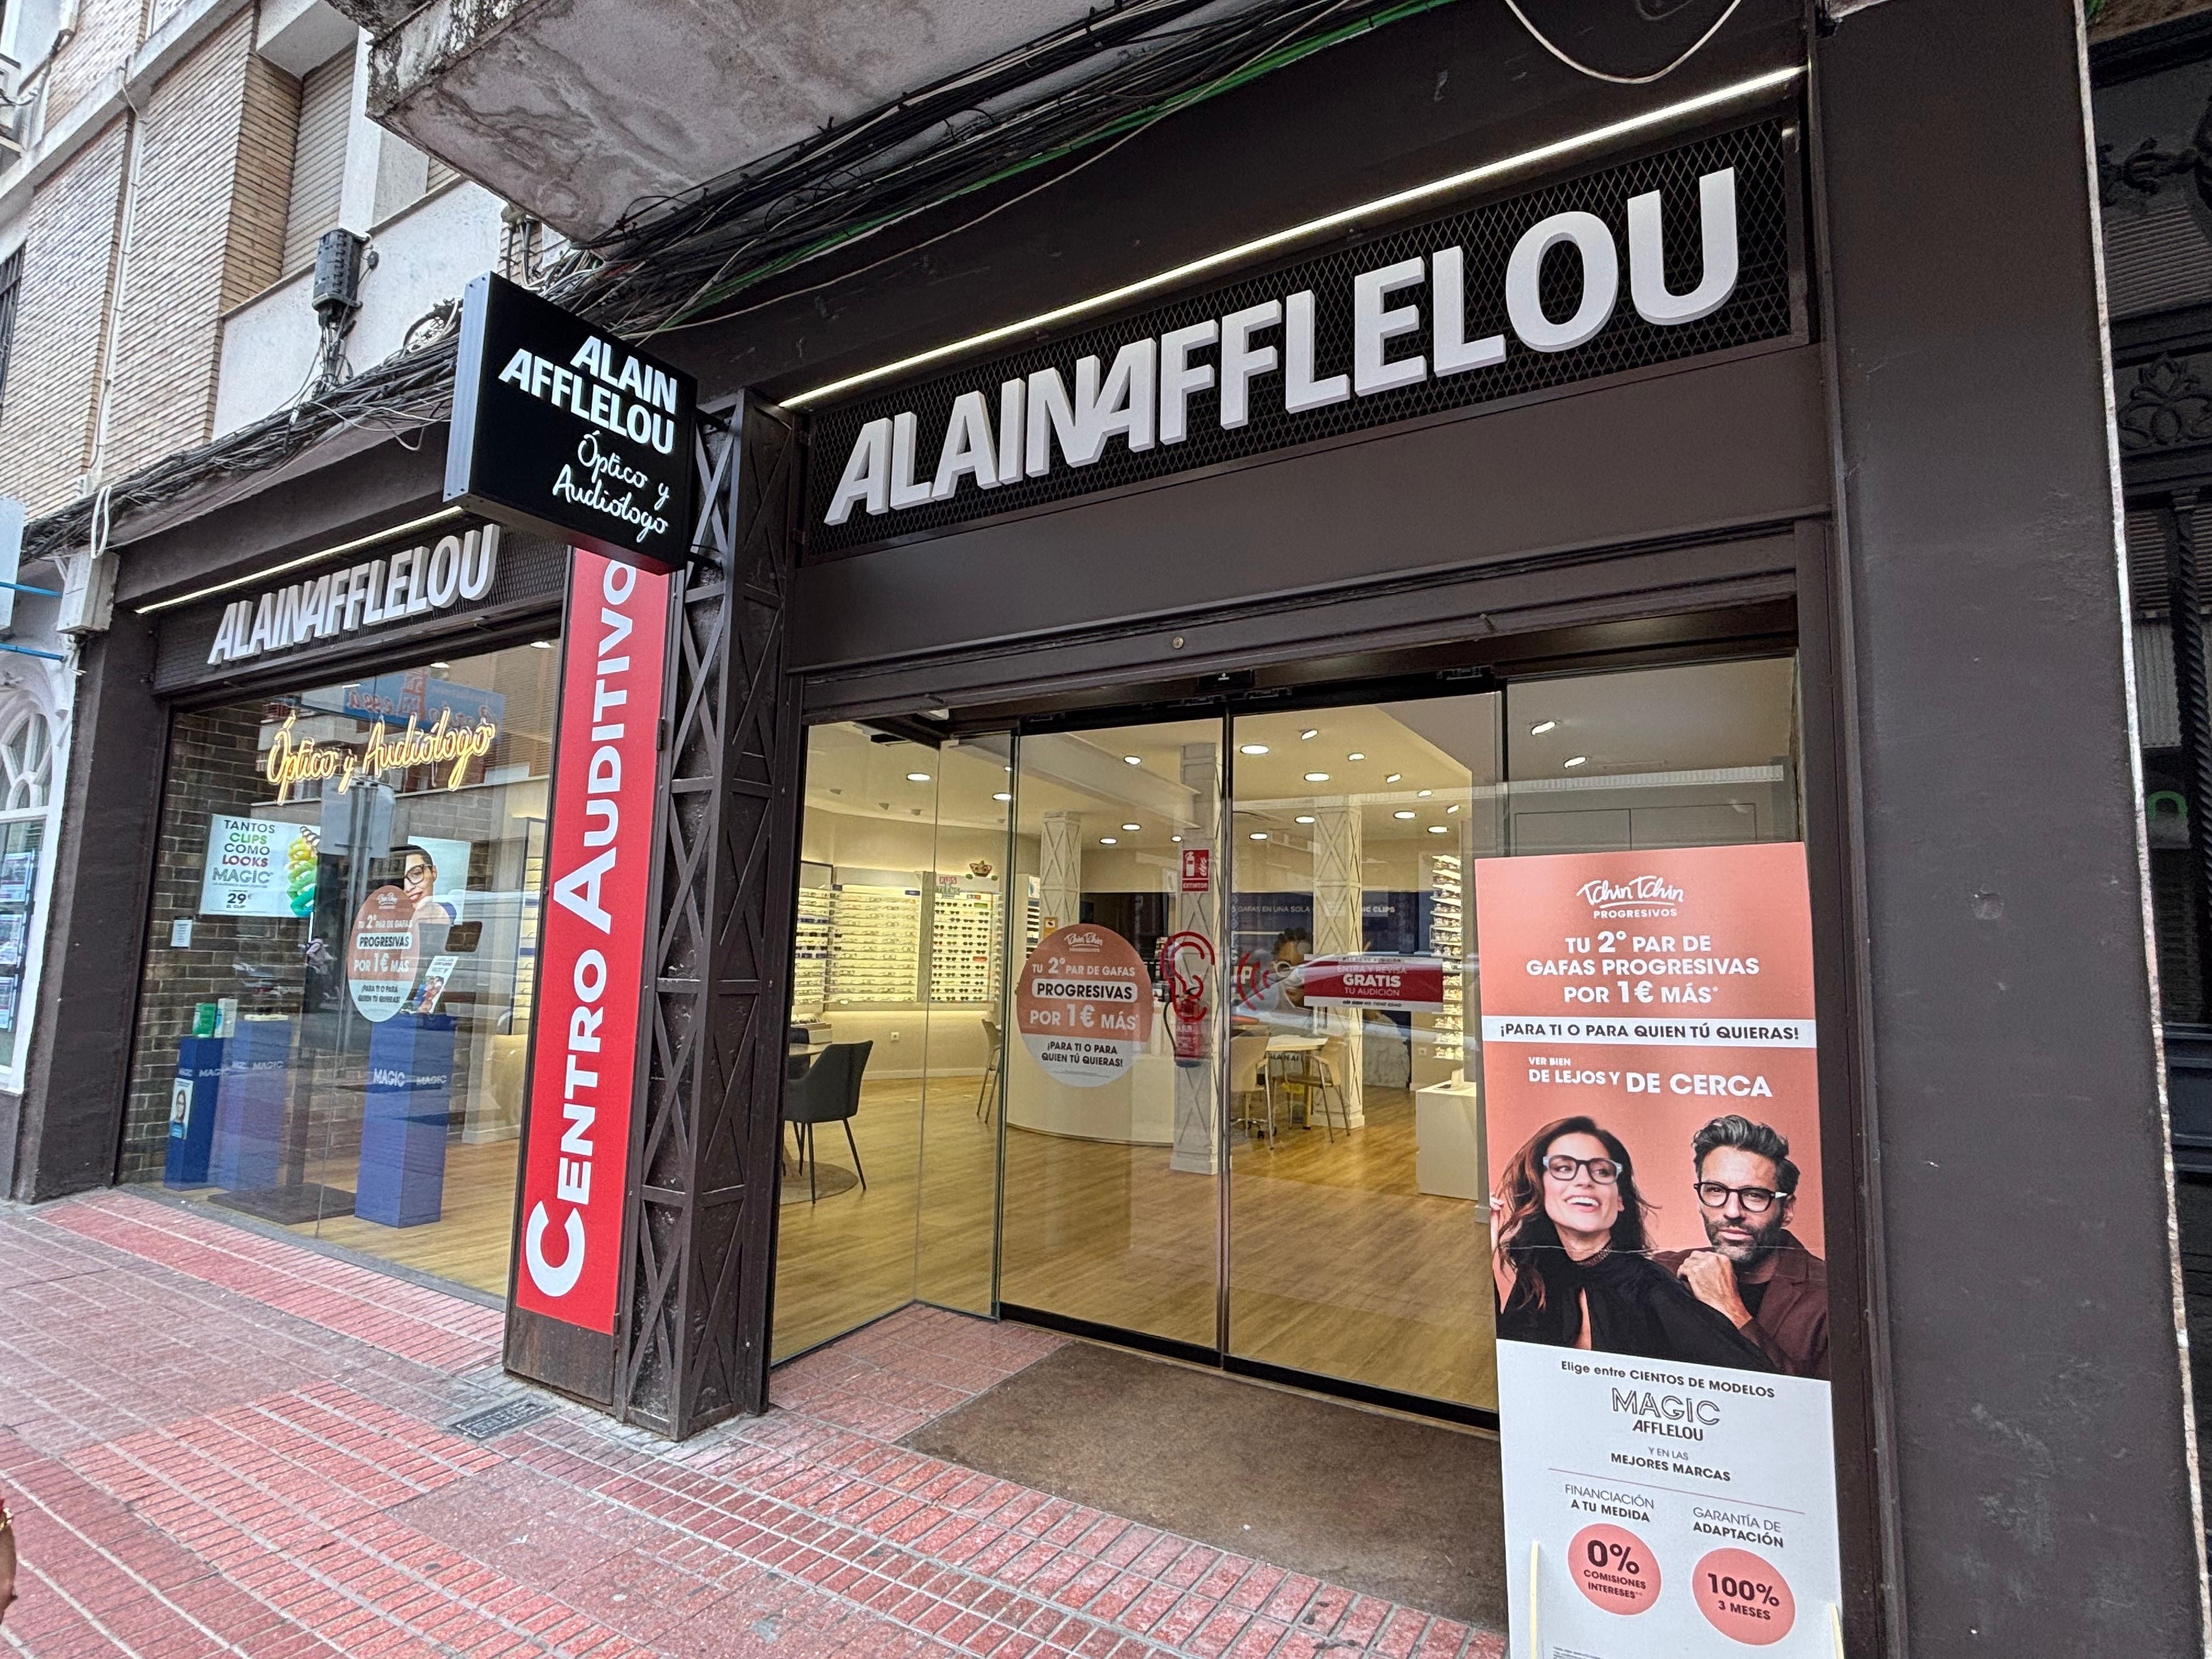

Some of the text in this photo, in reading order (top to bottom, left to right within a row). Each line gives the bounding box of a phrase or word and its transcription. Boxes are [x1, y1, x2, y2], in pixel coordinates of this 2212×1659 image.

[570, 335, 677, 414] ALAIN
[498, 348, 675, 454] AFFLELOU
[578, 430, 670, 511] Óptico y
[552, 464, 668, 543] Audiólogo
[267, 709, 339, 805] Óptico
[337, 749, 357, 795] y
[363, 707, 496, 791] Audiólogo
[224, 820, 275, 833] TANTOS
[229, 832, 268, 844] CLIPS
[224, 843, 270, 855] COMO
[222, 854, 268, 867] LOOKS
[1593, 908, 1677, 919] PROGRESIVOS
[359, 935, 410, 947] PROGRESIVAS
[1565, 937, 1590, 953] TU
[1633, 936, 1675, 952] PAR
[1683, 935, 1711, 951] DE
[354, 960, 371, 972] POR
[1031, 963, 1043, 974] TU
[1065, 965, 1084, 975] PAR
[1087, 966, 1099, 975] DE
[1102, 966, 1136, 977] GAFAS
[1337, 965, 1365, 973] ENTRA
[1375, 966, 1407, 974] REVISA
[1526, 957, 1759, 975] GAFAS PROGRESIVAS
[1343, 973, 1401, 988] GRATIS
[1037, 983, 1132, 1000] PROGRESIVAS
[1357, 988, 1400, 996] AUDICIÓN
[1564, 986, 1610, 1003] POR
[1030, 1009, 1061, 1025] POR
[1500, 1023, 1799, 1040] ¡PARA TI O PARA QUIEN TÚ QUIERAS!
[1047, 1041, 1118, 1054] ¡PARA TI O PARA
[1041, 1052, 1123, 1068] QUIEN TÚ QUIERAS!
[1528, 1057, 1571, 1066] VER BIEN
[373, 1068, 405, 1087] MAGIC
[416, 1075, 447, 1085] MAGIC
[1528, 1069, 1773, 1097] DE LEJOS Y DE CERCA
[1561, 1361, 1775, 1398] Elige entre CIENTOS DE MODELOS
[1612, 1387, 1720, 1425] MAGIC
[1633, 1420, 1703, 1441] AFFLELOU
[1648, 1446, 1689, 1460] Y EN LAS
[1611, 1453, 1731, 1482] MEJORES MARCAS
[1565, 1484, 1654, 1509] FINANCIACIÓN
[1571, 1500, 1650, 1523] A TU MEDIDA
[1693, 1507, 1781, 1532] GARANTÍA DE
[1693, 1522, 1784, 1548] ADAPTACIÓN
[1587, 1539, 1640, 1575] 0%
[1583, 1569, 1646, 1589] COMISIONES
[1707, 1572, 1780, 1607] 100%
[1718, 1600, 1771, 1621] 3 MESES
